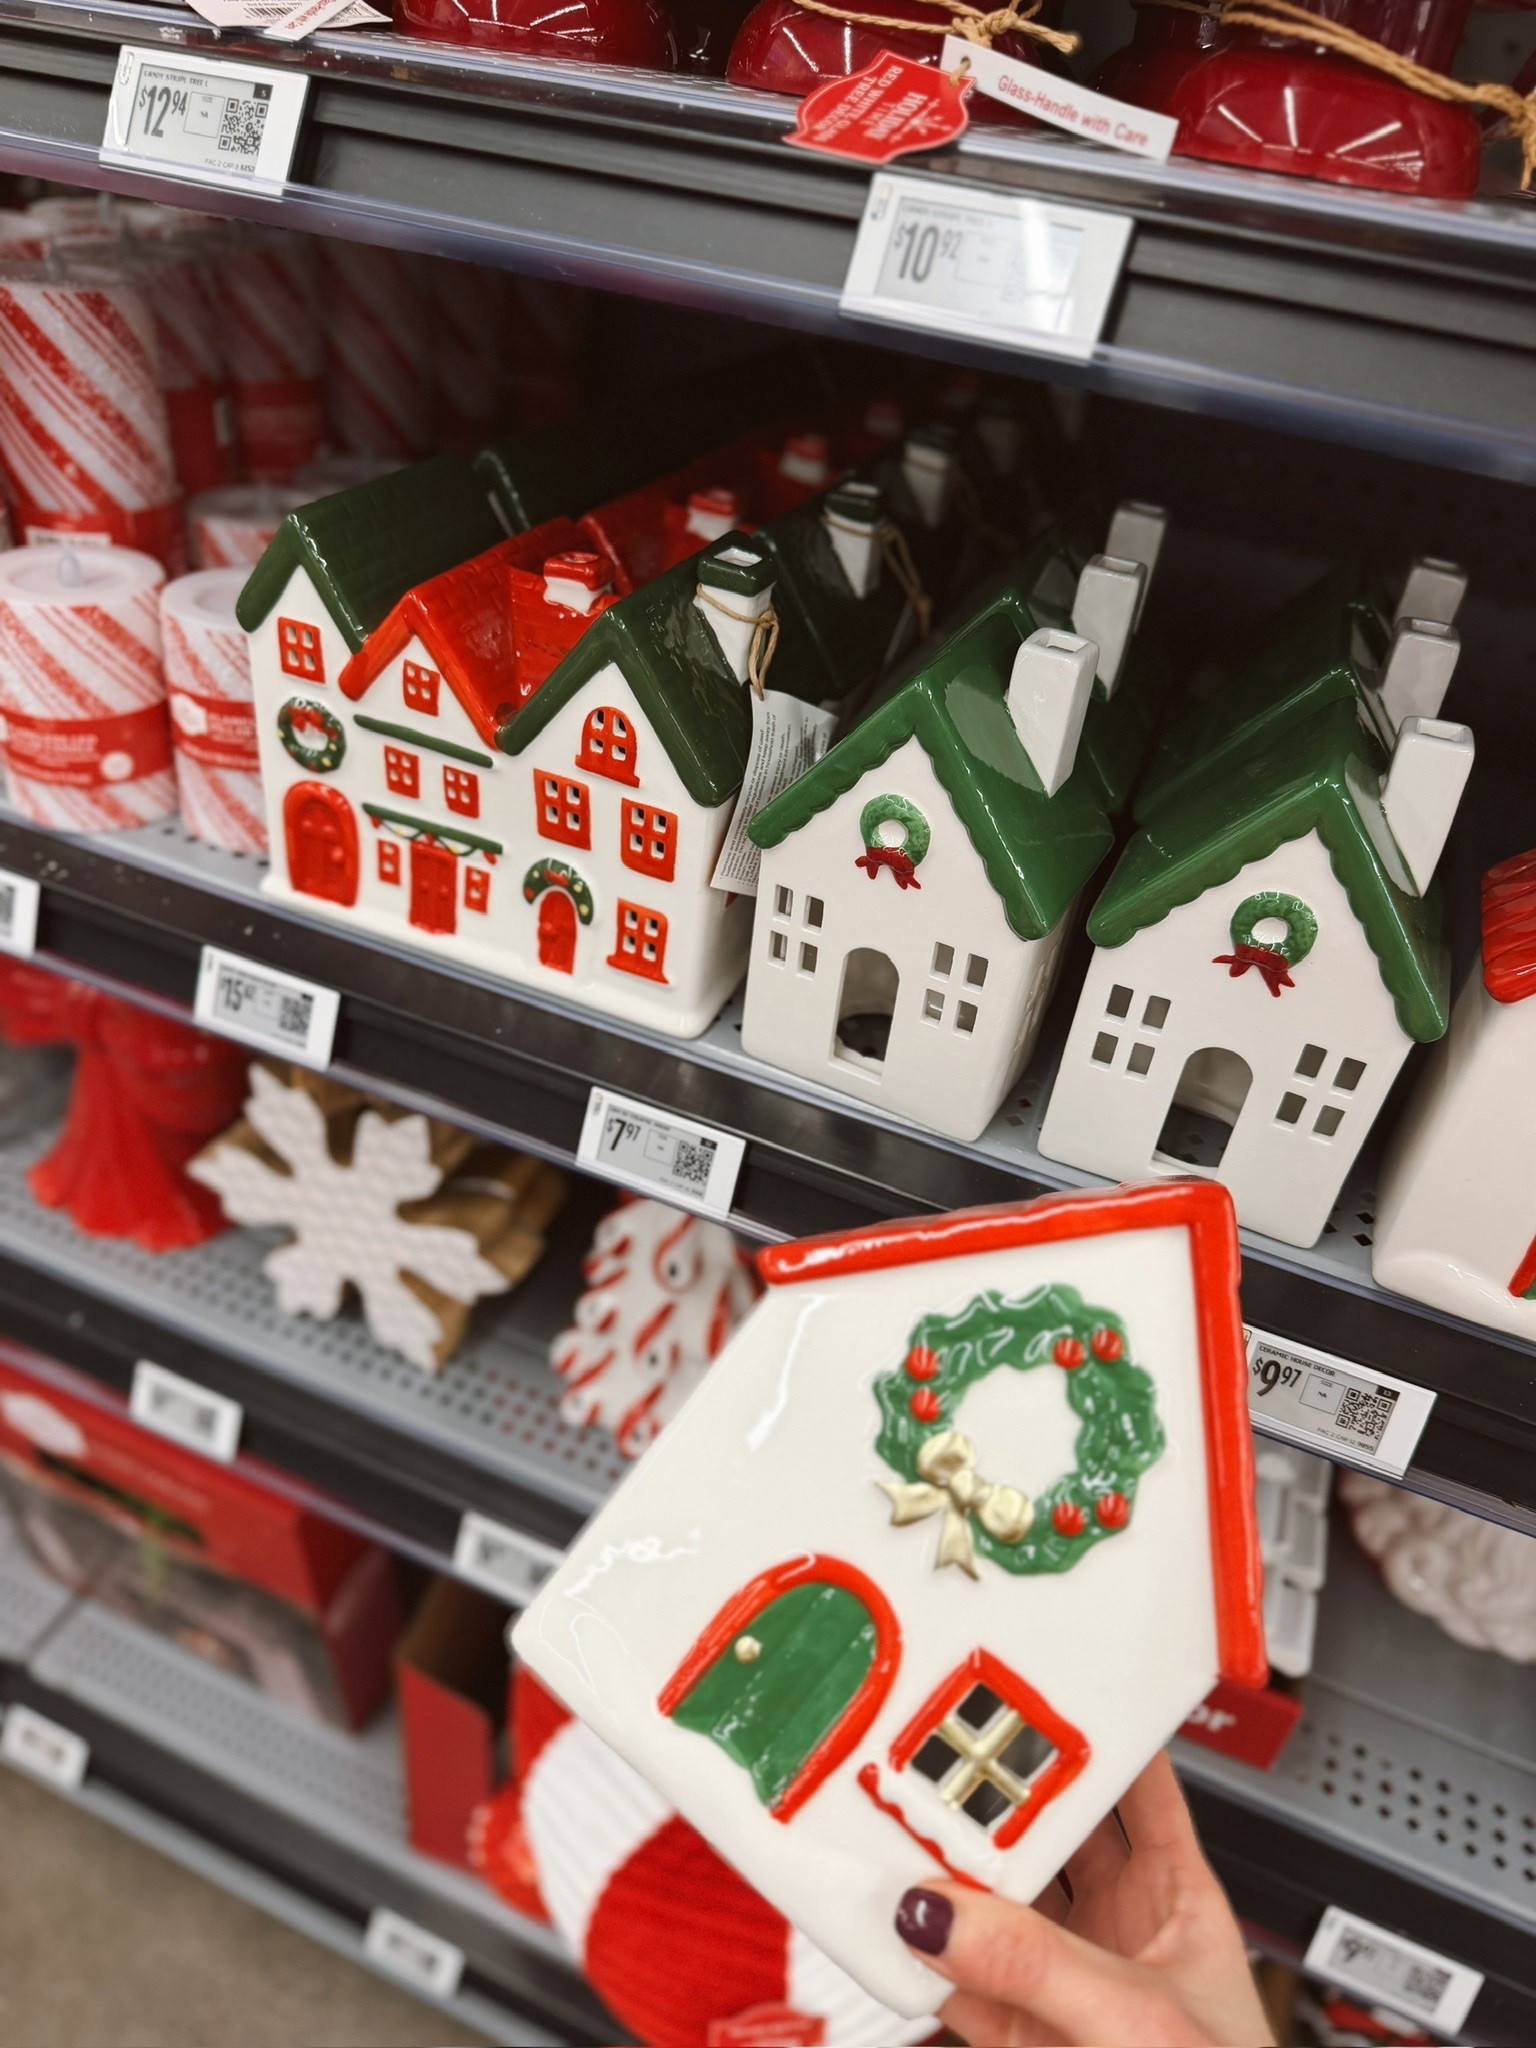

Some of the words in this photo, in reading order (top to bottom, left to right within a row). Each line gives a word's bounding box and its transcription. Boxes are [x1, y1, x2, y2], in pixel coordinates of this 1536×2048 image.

[844, 77, 877, 103] TREE
[877, 65, 904, 88] RED
[863, 91, 929, 139] HOLIDAY
[998, 74, 1080, 122] Glass-Handle
[1080, 113, 1113, 134] with
[1113, 122, 1150, 147] Care
[1258, 1346, 1290, 1360] CERAMIC
[1290, 1356, 1313, 1369] HOUSE
[1313, 1364, 1336, 1377] DECOR
